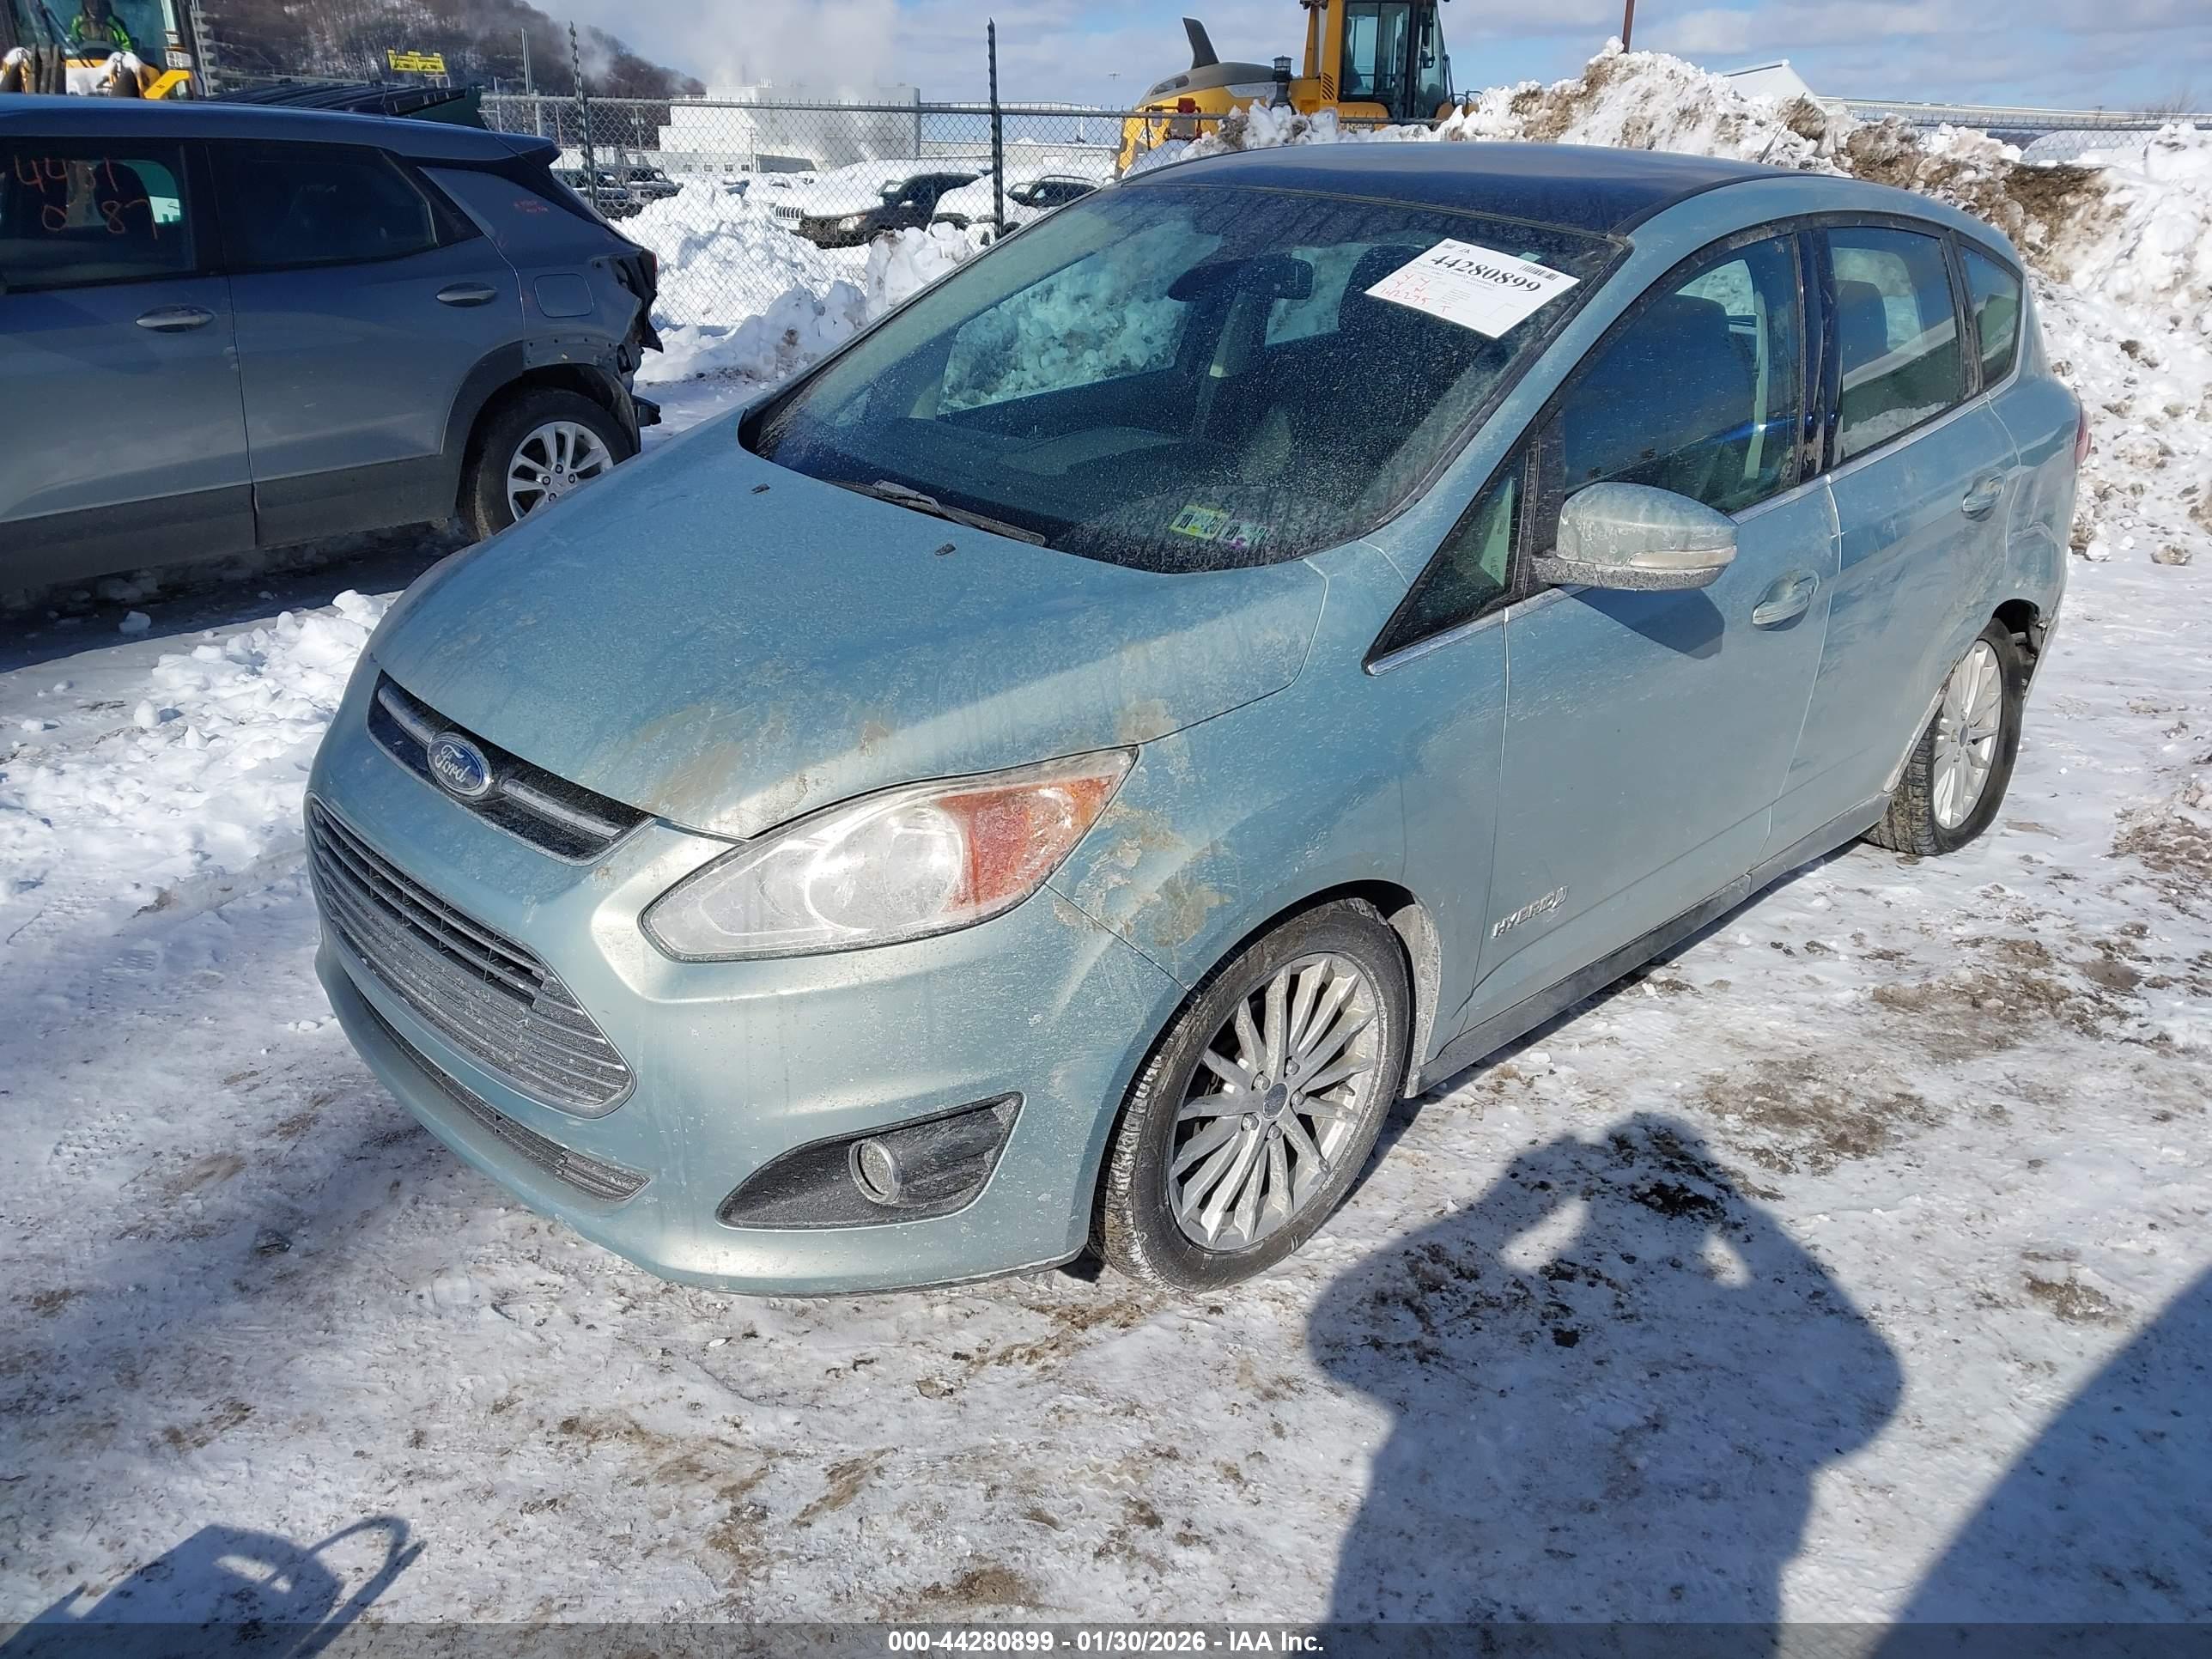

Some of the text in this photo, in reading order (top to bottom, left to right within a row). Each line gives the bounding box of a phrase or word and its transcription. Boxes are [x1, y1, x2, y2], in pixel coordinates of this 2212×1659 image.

[1431, 255, 1541, 292] 44280899
[434, 744, 471, 783] Ford
[1491, 885, 1570, 939] HYBRID
